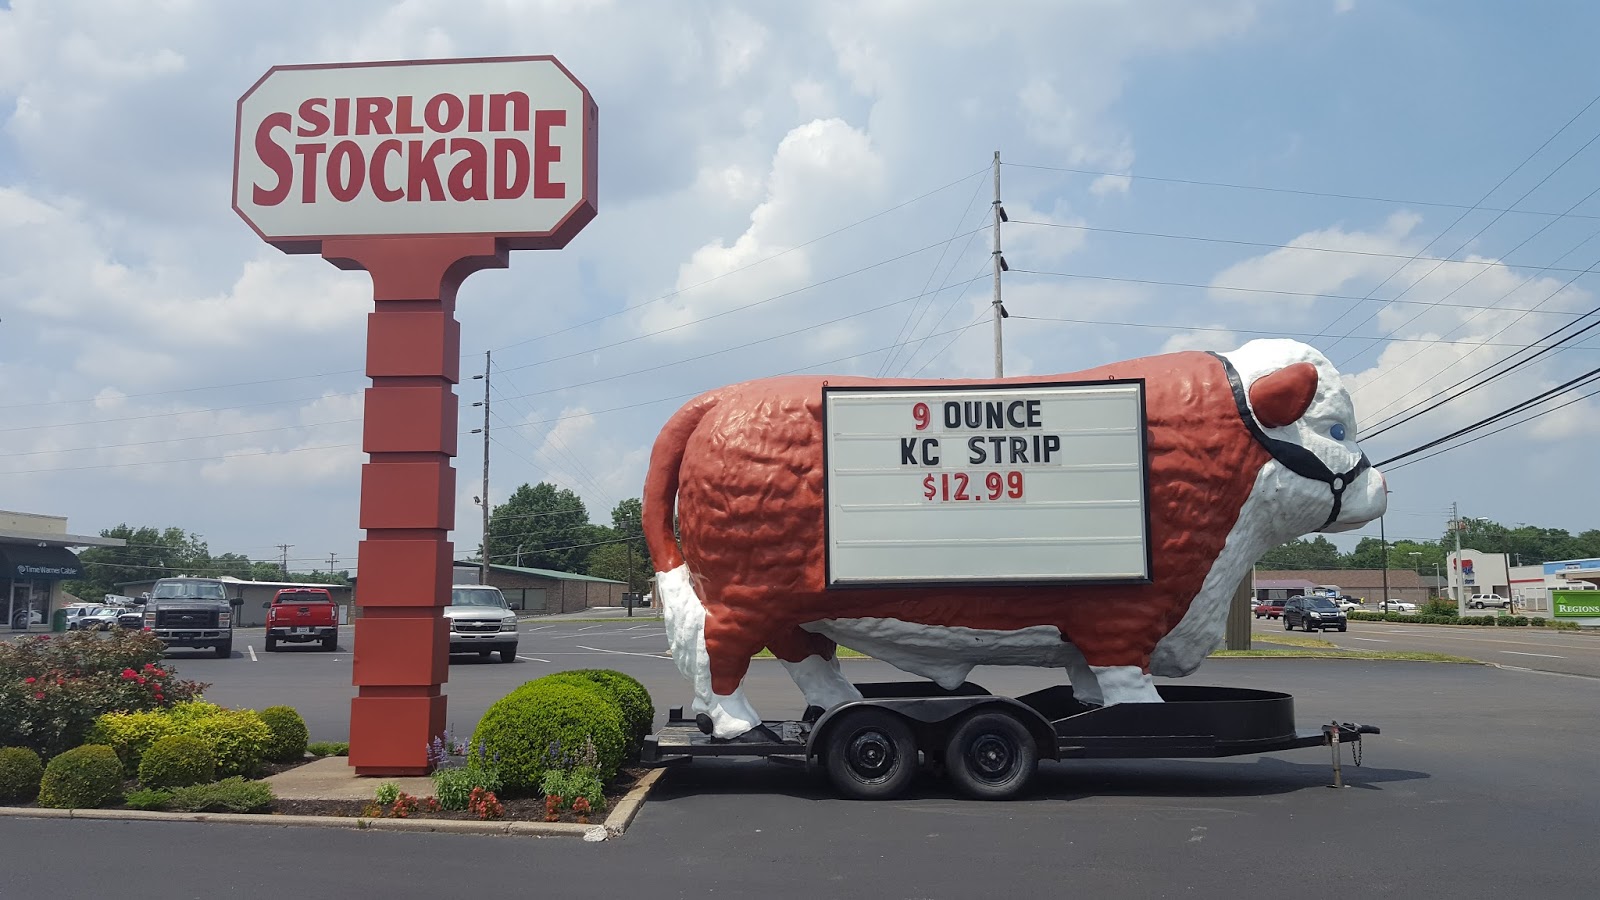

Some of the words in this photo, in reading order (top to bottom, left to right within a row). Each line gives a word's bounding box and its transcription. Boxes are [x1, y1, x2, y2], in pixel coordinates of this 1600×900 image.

[912, 402, 931, 431] 9
[943, 400, 1042, 429] OUNCE
[900, 437, 940, 466] KC
[967, 435, 1061, 465] STRIP
[922, 470, 1024, 502] $12.99
[25, 565, 40, 573] Time
